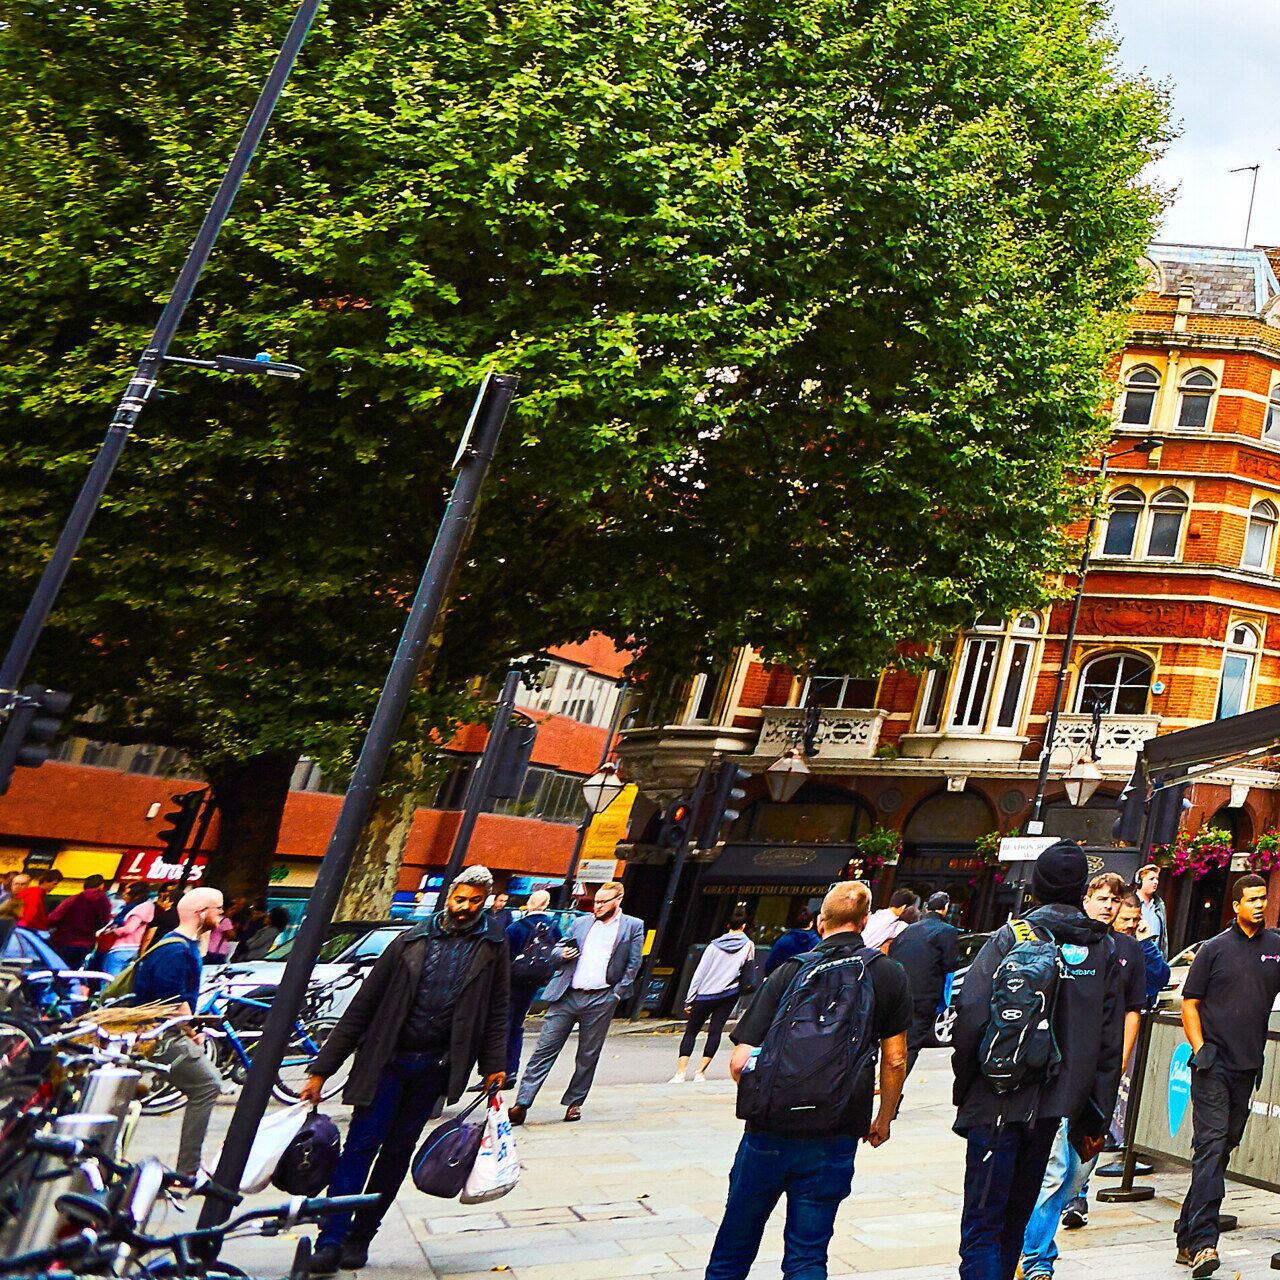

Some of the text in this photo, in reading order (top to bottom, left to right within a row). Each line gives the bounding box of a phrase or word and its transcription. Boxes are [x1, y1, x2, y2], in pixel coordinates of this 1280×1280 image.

[703, 885, 736, 894] GREAT
[738, 885, 777, 895] BRITISH
[780, 886, 799, 895] PUB
